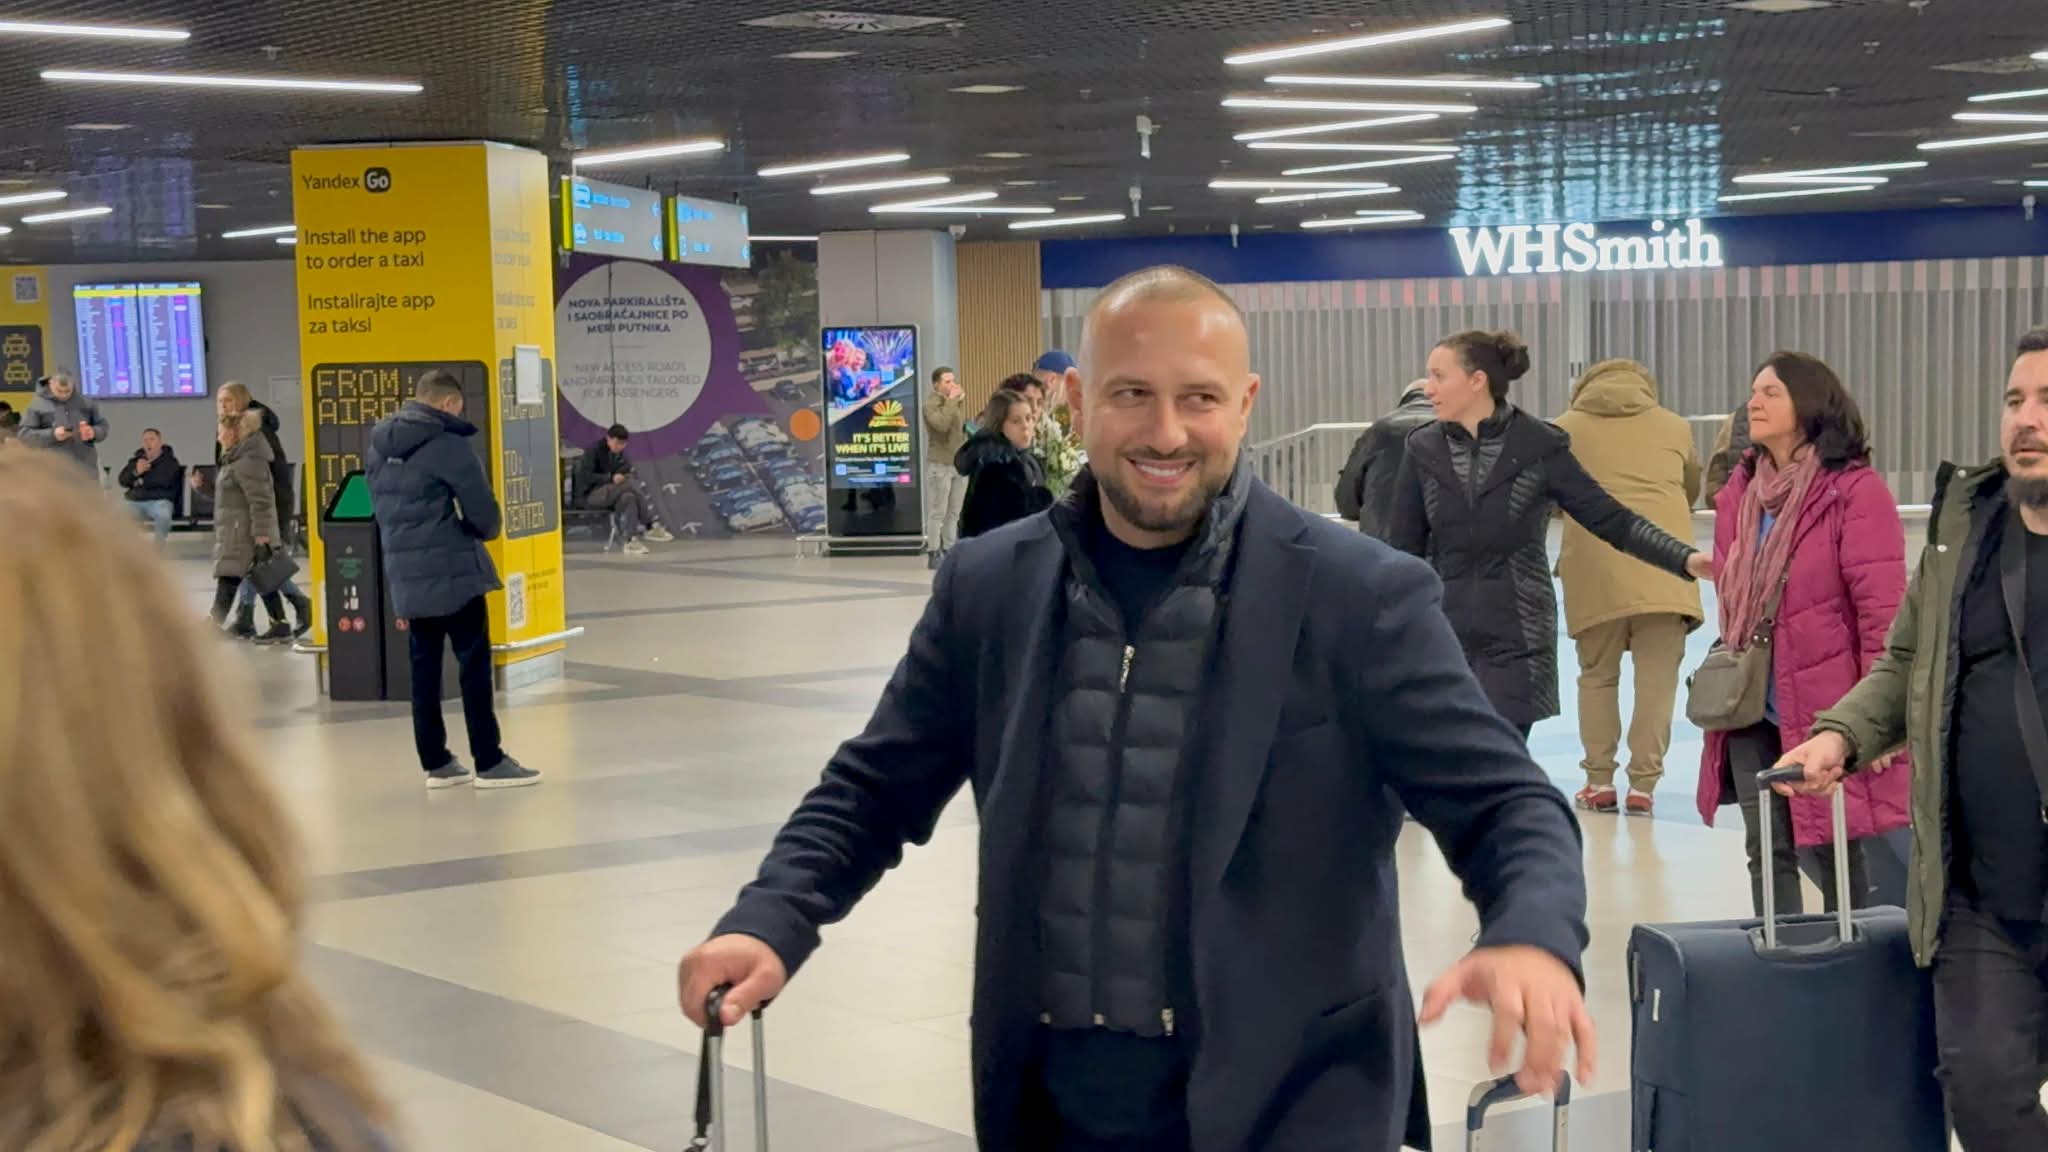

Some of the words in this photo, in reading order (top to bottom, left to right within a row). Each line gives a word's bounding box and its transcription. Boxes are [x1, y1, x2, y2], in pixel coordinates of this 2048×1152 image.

[302, 173, 360, 190] Yandex
[366, 170, 390, 189] Go
[304, 228, 356, 245] Install
[360, 228, 388, 245] the
[392, 229, 426, 248] app
[1449, 218, 1724, 276] WHSmith
[305, 256, 324, 270] to
[327, 253, 374, 269] order
[379, 255, 389, 267] a
[393, 251, 425, 267] taxi
[307, 292, 399, 313] Instalirajte
[403, 293, 436, 311] app
[569, 299, 600, 308] NOVA
[672, 310, 689, 320] PO
[309, 320, 328, 334] za
[331, 317, 373, 333] taksi
[587, 323, 616, 335] MERI
[618, 323, 671, 334] PUTNIKA
[853, 433, 871, 443] IT'S
[872, 432, 909, 442] BETTER
[835, 445, 867, 454] WHEN
[869, 443, 886, 453] IT'S
[888, 443, 909, 453] LIVE
